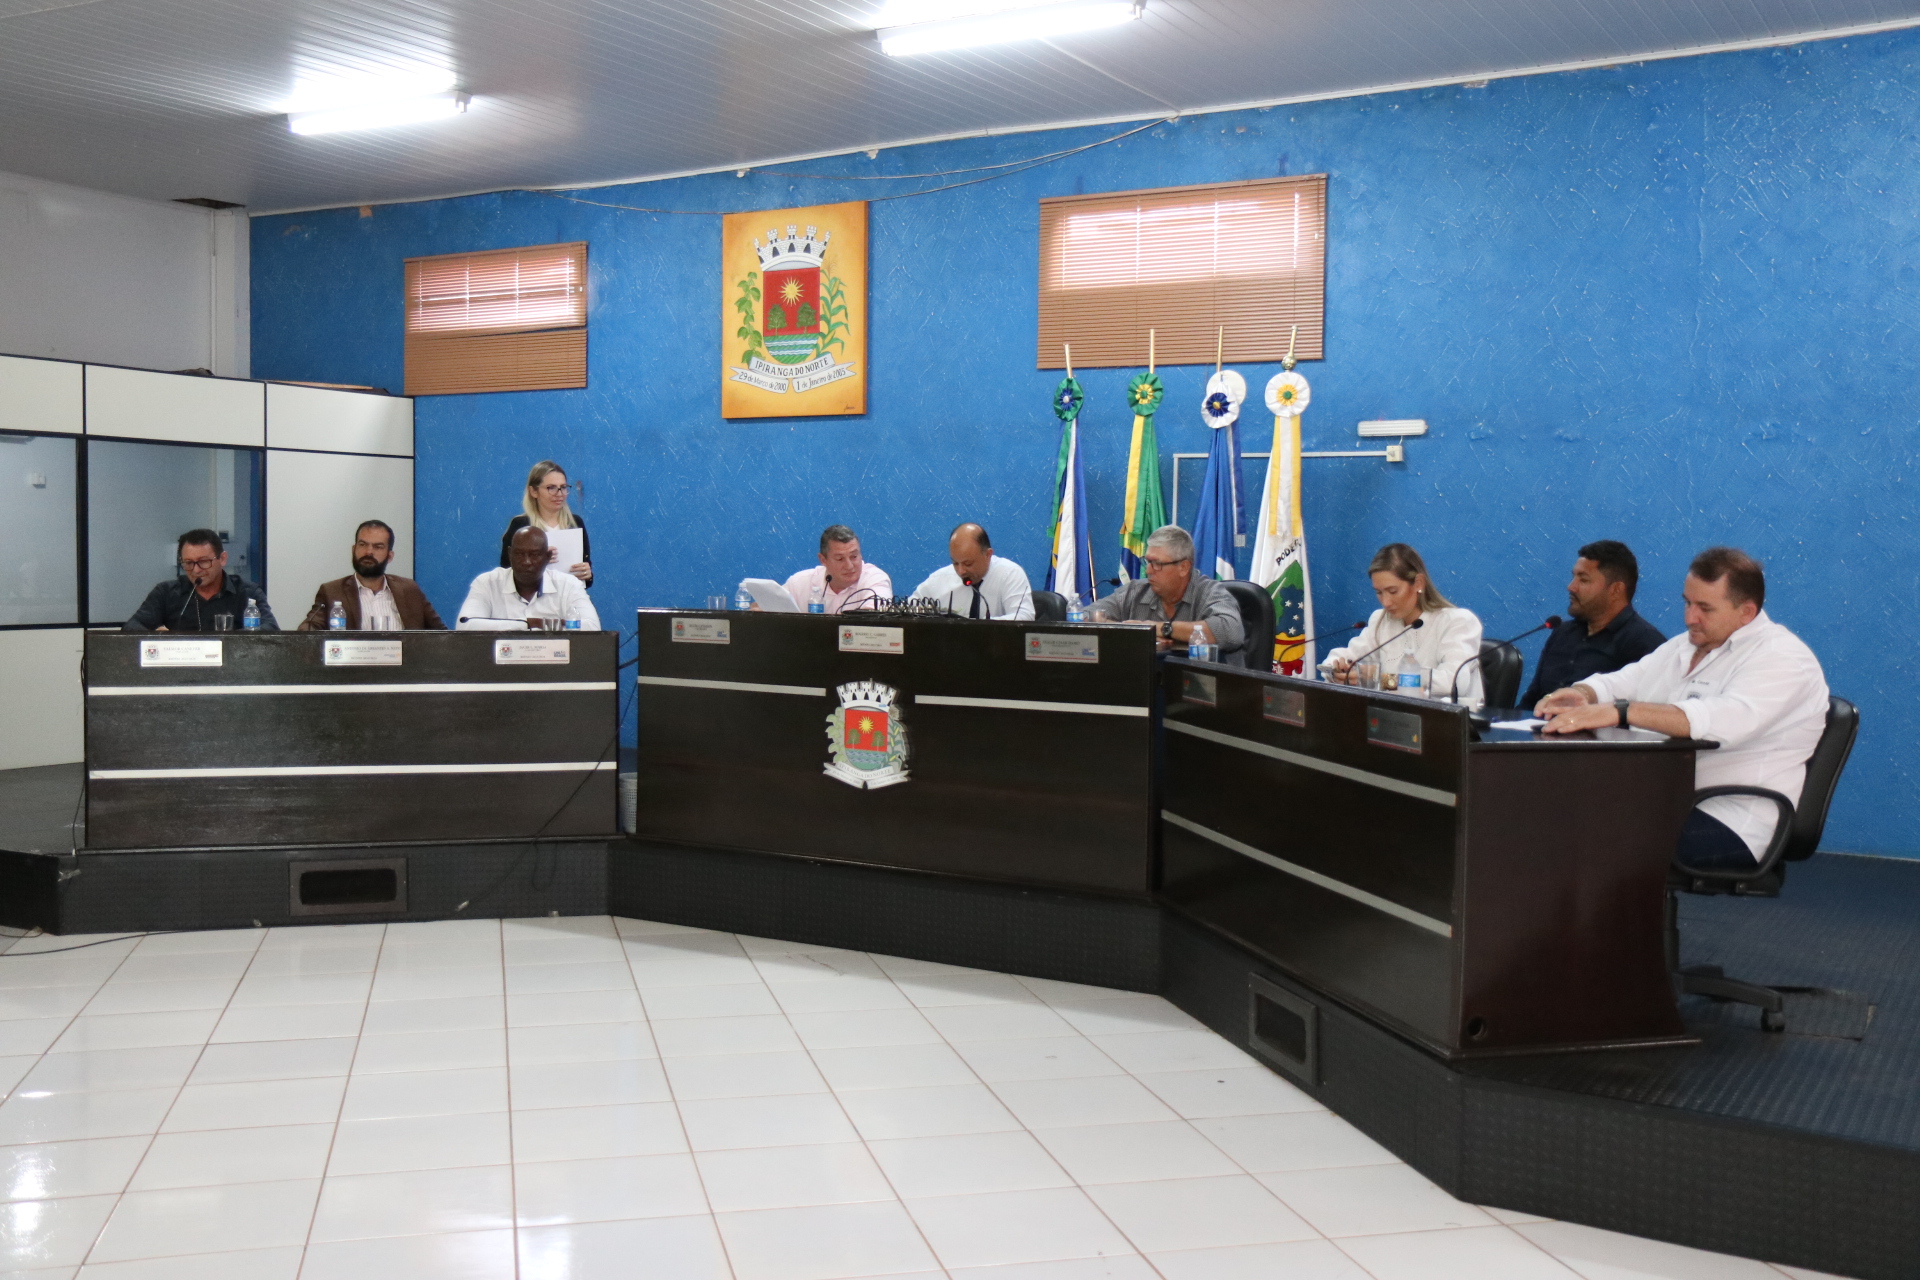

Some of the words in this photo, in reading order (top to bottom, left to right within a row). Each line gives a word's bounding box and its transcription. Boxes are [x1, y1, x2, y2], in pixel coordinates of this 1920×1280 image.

[755, 360, 794, 377] IPIRANGA
[795, 367, 804, 376] DO
[805, 356, 829, 373] NORTE
[738, 371, 748, 380] 29
